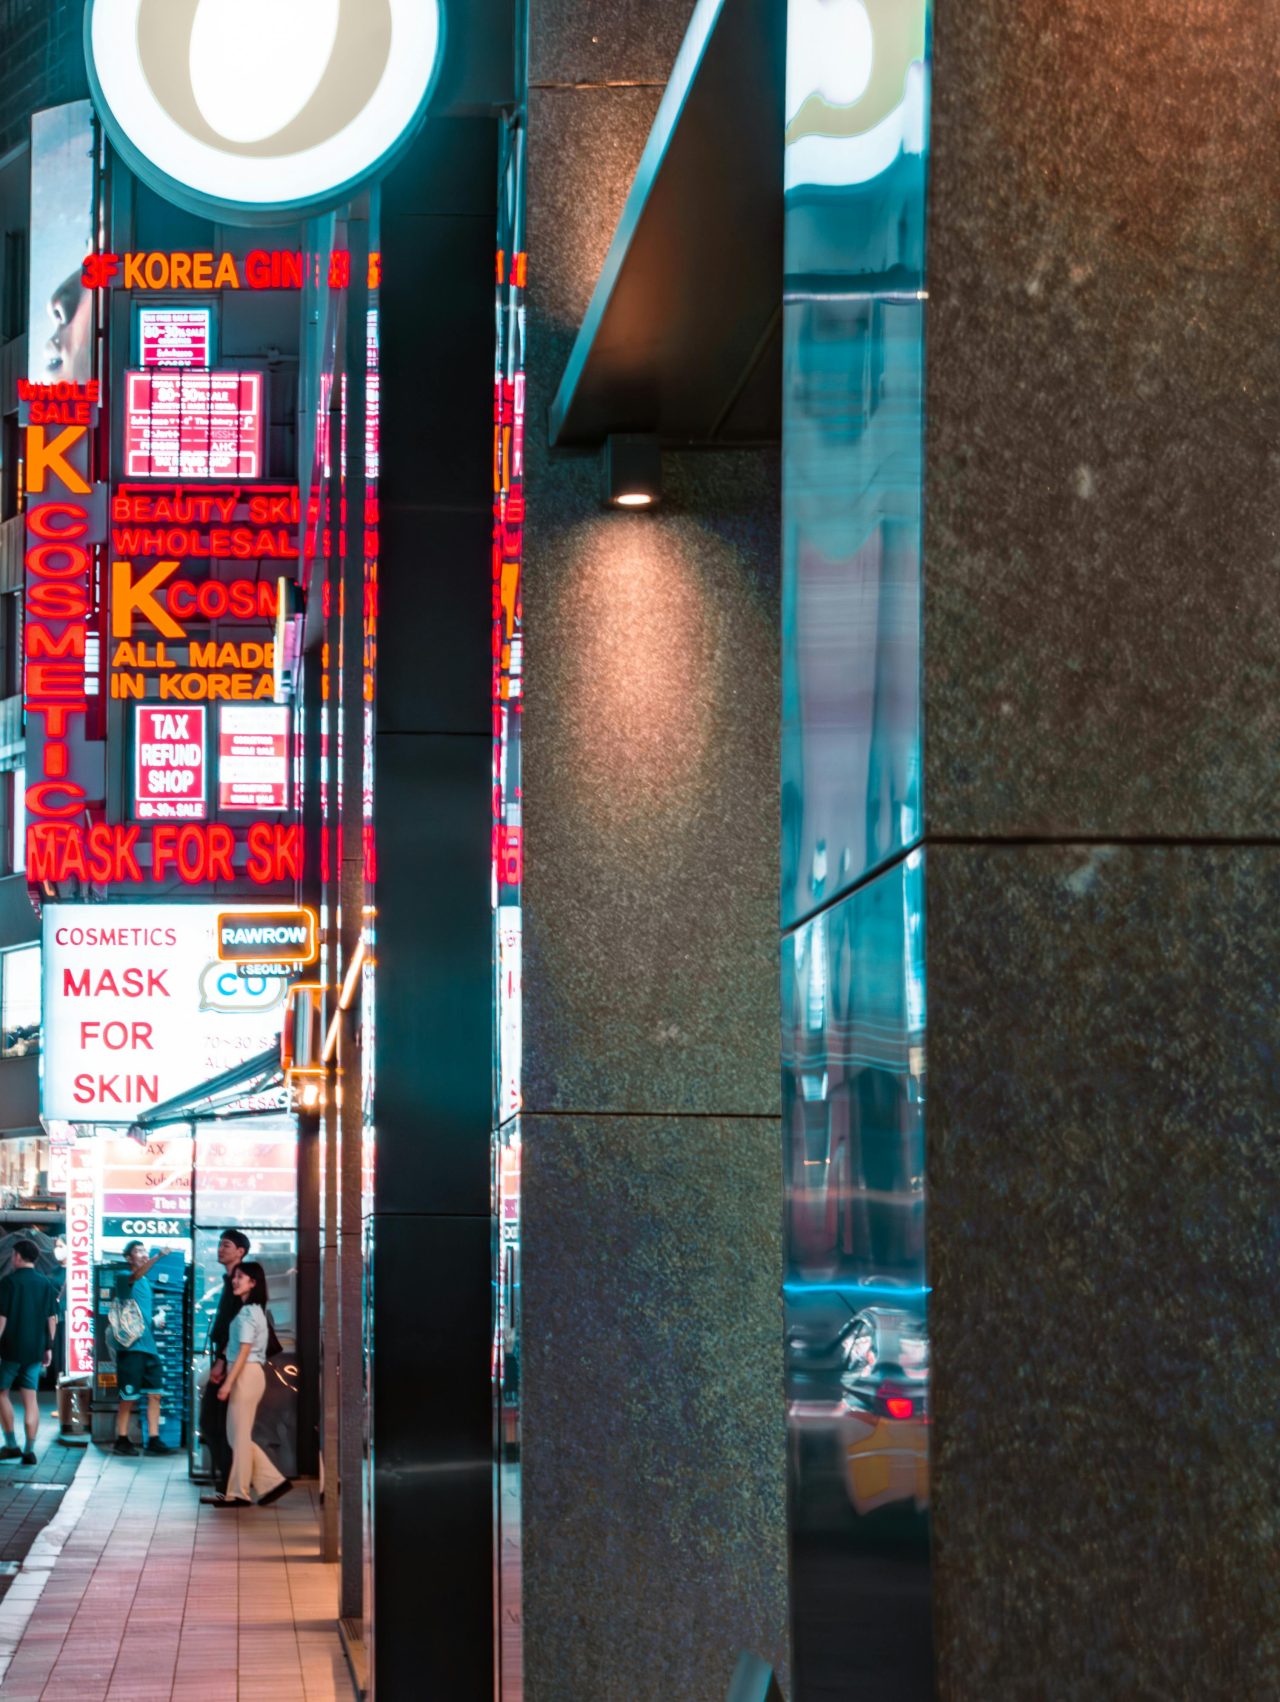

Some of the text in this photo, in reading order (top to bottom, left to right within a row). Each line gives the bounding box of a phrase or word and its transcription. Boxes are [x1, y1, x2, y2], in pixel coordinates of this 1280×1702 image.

[81, 249, 303, 289] 3F KOREA GIN
[18, 378, 100, 401] WHOLE
[29, 402, 91, 425] SALE
[25, 426, 93, 494] K
[112, 495, 301, 524] BEAUTY SKI
[112, 528, 300, 557] WHOLESAL
[112, 560, 187, 639] K
[111, 640, 274, 669] ALL MADE
[111, 672, 274, 700] IN KOREA
[150, 714, 190, 740] TAX
[141, 743, 202, 768] REFUND
[148, 768, 195, 794] SHOP
[26, 822, 143, 884] MASK
[152, 822, 234, 884] FOR
[56, 927, 177, 947] COSMETICS
[221, 926, 307, 945] RAWROW
[63, 967, 171, 998] MASK
[217, 972, 267, 996] CU
[80, 1020, 154, 1050] FOR
[72, 1073, 159, 1105] SKIN
[122, 1220, 180, 1235] COSRX
[71, 1204, 89, 1334] COSMETICS
